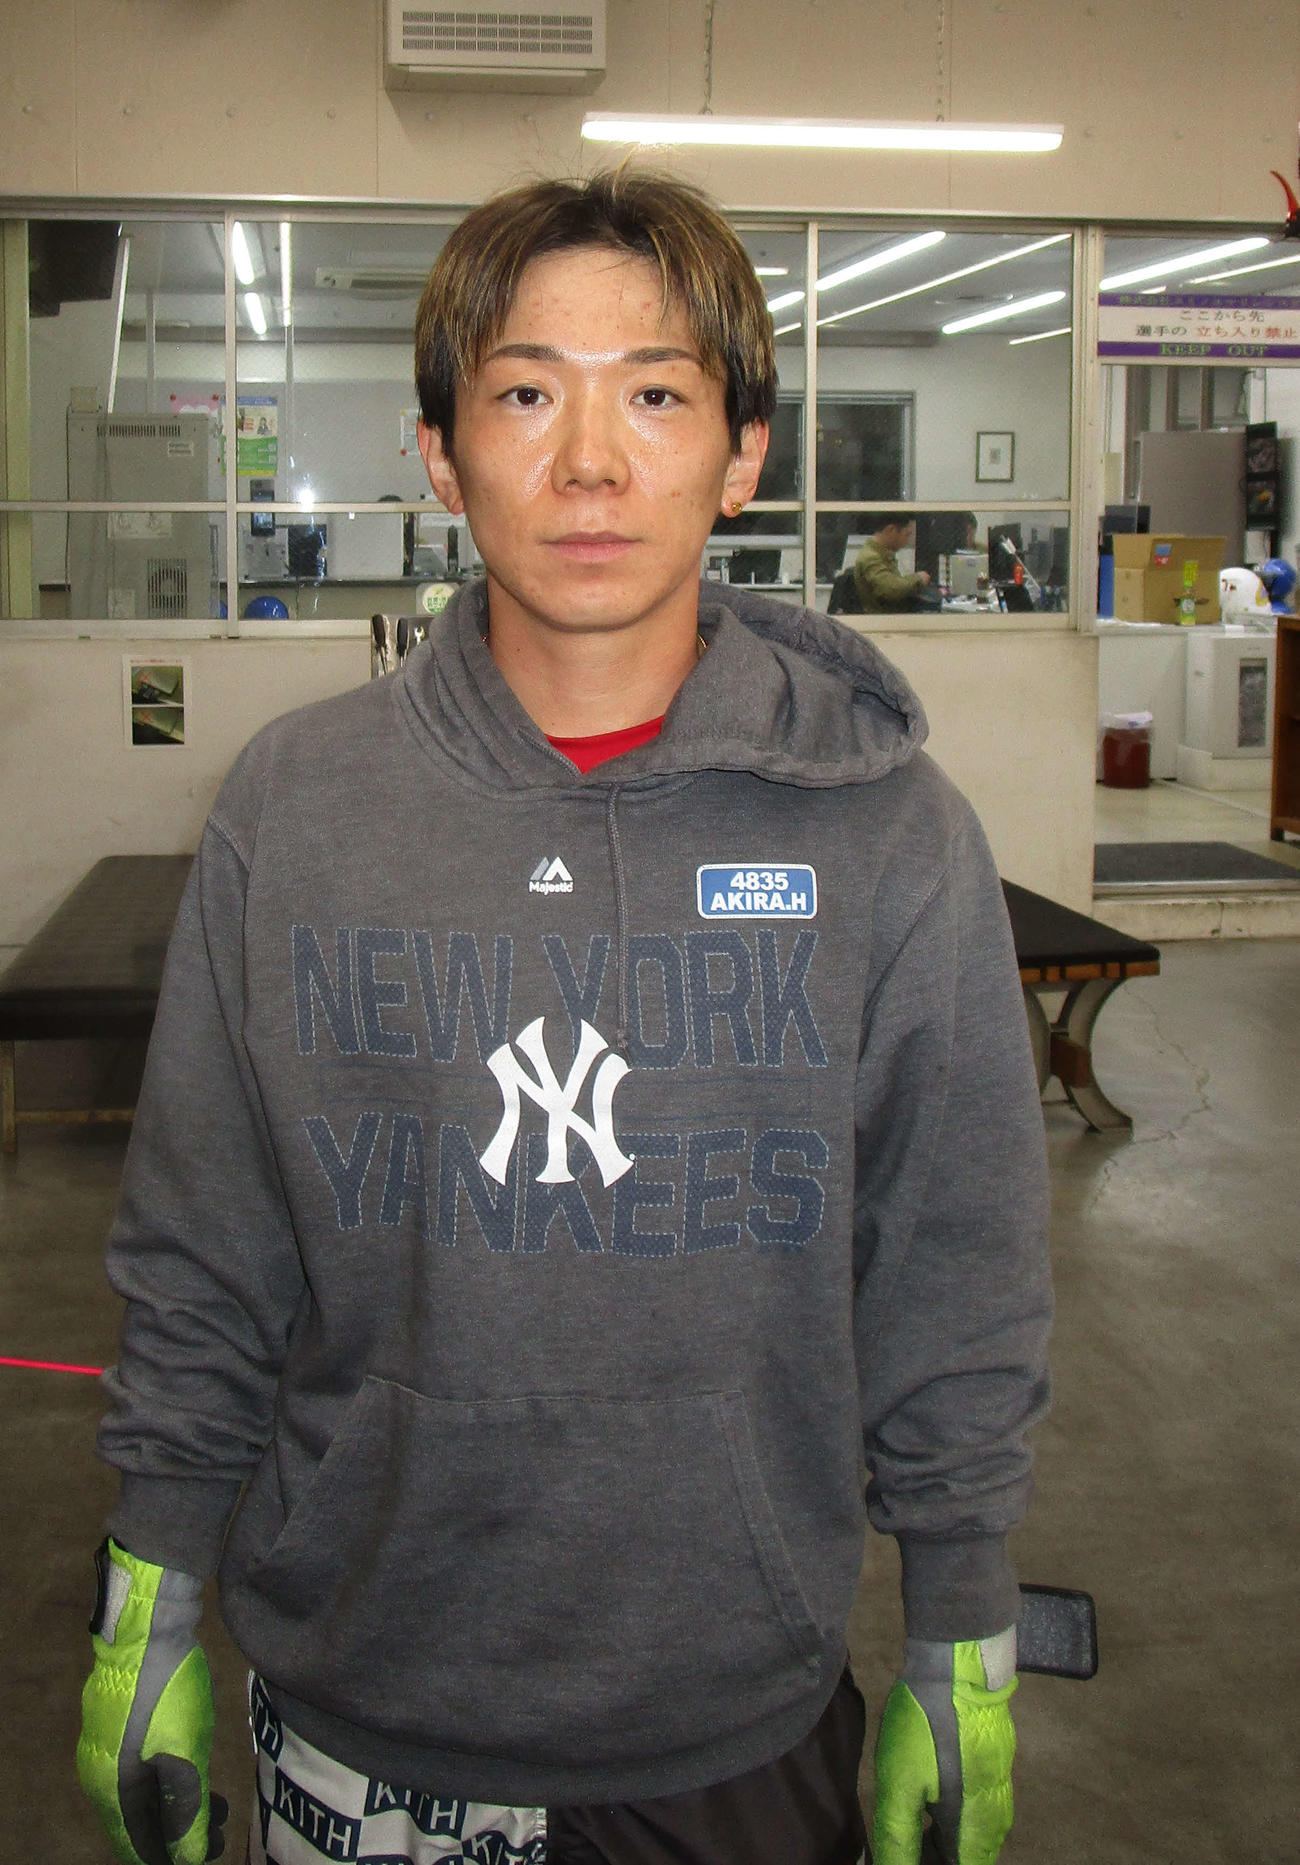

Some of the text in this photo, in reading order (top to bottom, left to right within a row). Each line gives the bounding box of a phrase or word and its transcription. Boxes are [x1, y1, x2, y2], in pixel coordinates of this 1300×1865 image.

[1179, 309, 1265, 322] ここから先
[1136, 325, 1297, 339] 選手の 立ち入り禁止
[1160, 343, 1268, 357] KEEP OUT
[528, 881, 574, 896] Majestic
[729, 871, 790, 891] 4835
[710, 892, 807, 911] AKIRA.H
[292, 925, 829, 1070] NEW YORK
[301, 1112, 830, 1257] YANKEES
[279, 1779, 352, 1858] KITH
